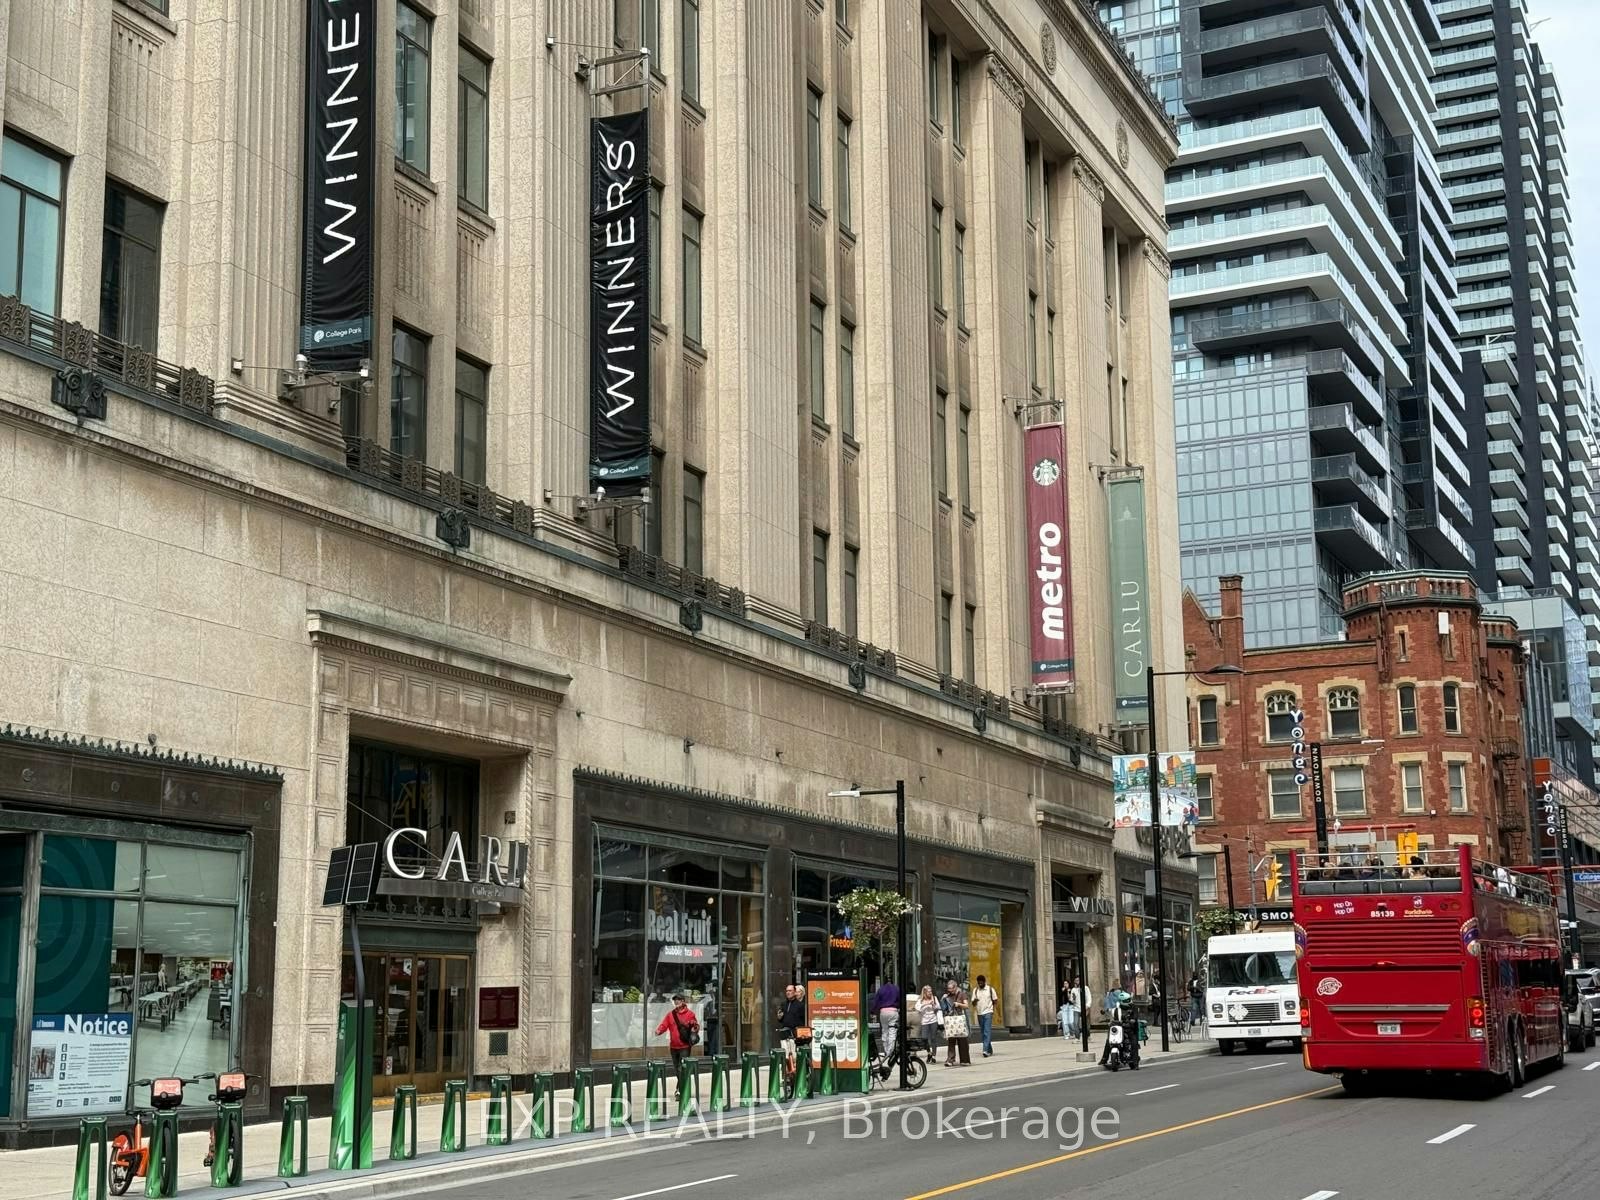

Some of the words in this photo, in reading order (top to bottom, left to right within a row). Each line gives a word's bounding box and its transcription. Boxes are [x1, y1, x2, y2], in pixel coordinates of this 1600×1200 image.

[323, 0, 361, 264] WINNE
[606, 139, 635, 418] WINNERS
[326, 330, 348, 338] College
[348, 327, 362, 335] Park
[1036, 522, 1064, 640] metro
[1121, 581, 1143, 678] CARLU
[1289, 709, 1306, 785] Yonge
[1312, 748, 1322, 803] DOWNTOWN
[1543, 781, 1556, 837] Yonge
[648, 909, 680, 944] Real
[682, 909, 712, 946] Fruit
[1228, 988, 1278, 996] FedEx
[64, 1014, 129, 1035] Notice
